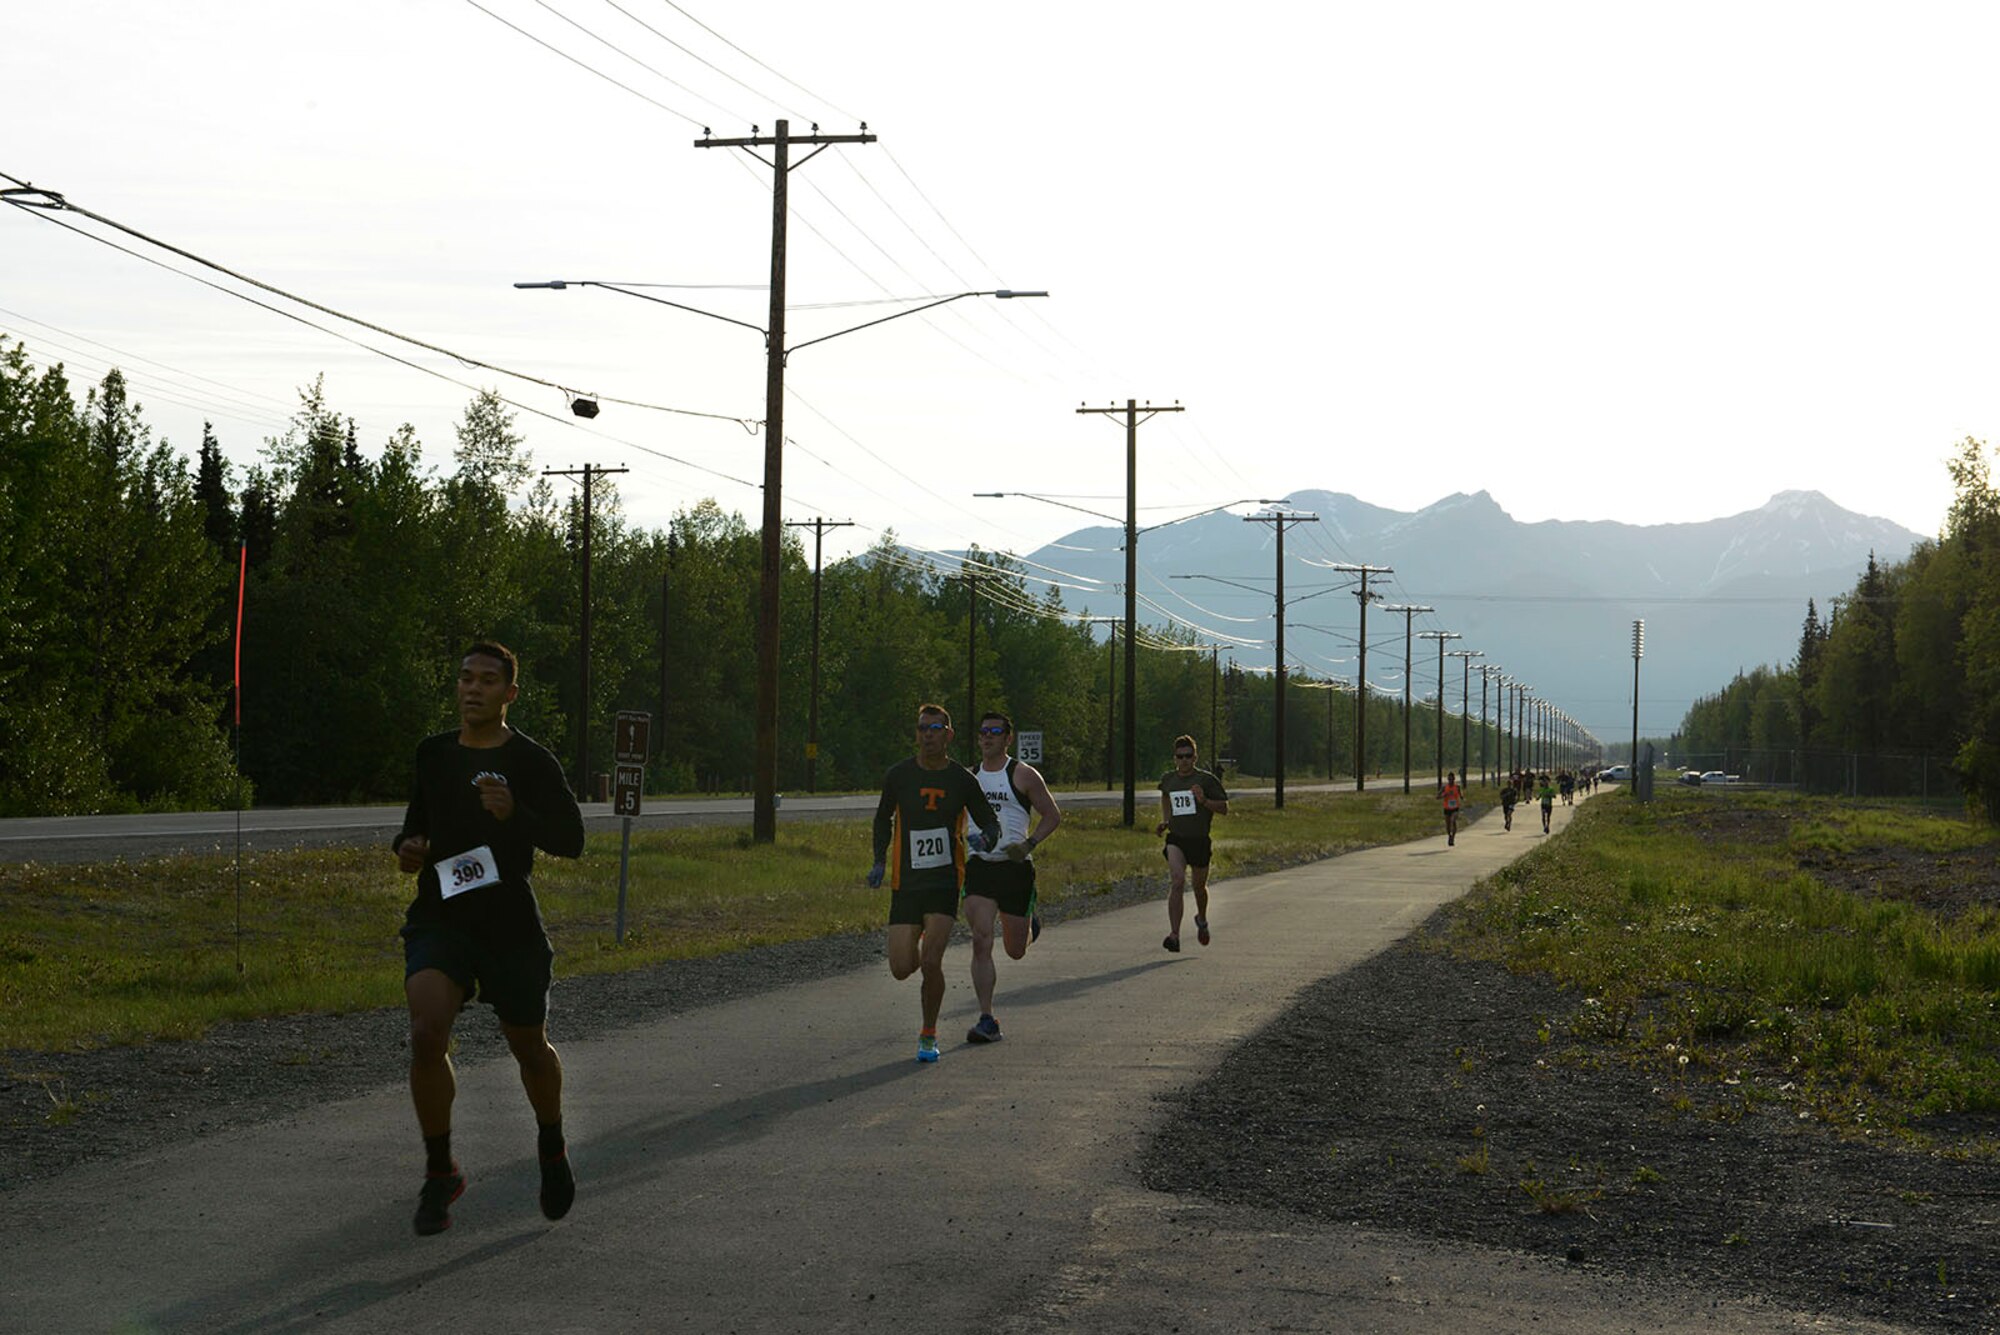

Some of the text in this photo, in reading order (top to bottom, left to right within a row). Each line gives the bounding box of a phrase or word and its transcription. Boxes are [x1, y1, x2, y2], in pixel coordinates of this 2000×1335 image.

[1020, 748, 1040, 760] 35
[618, 772, 640, 786] MILE
[919, 787, 945, 810] T
[985, 791, 1009, 801] ONAL
[1174, 796, 1191, 808] 278
[916, 837, 944, 857] 220
[452, 861, 485, 886] 390
